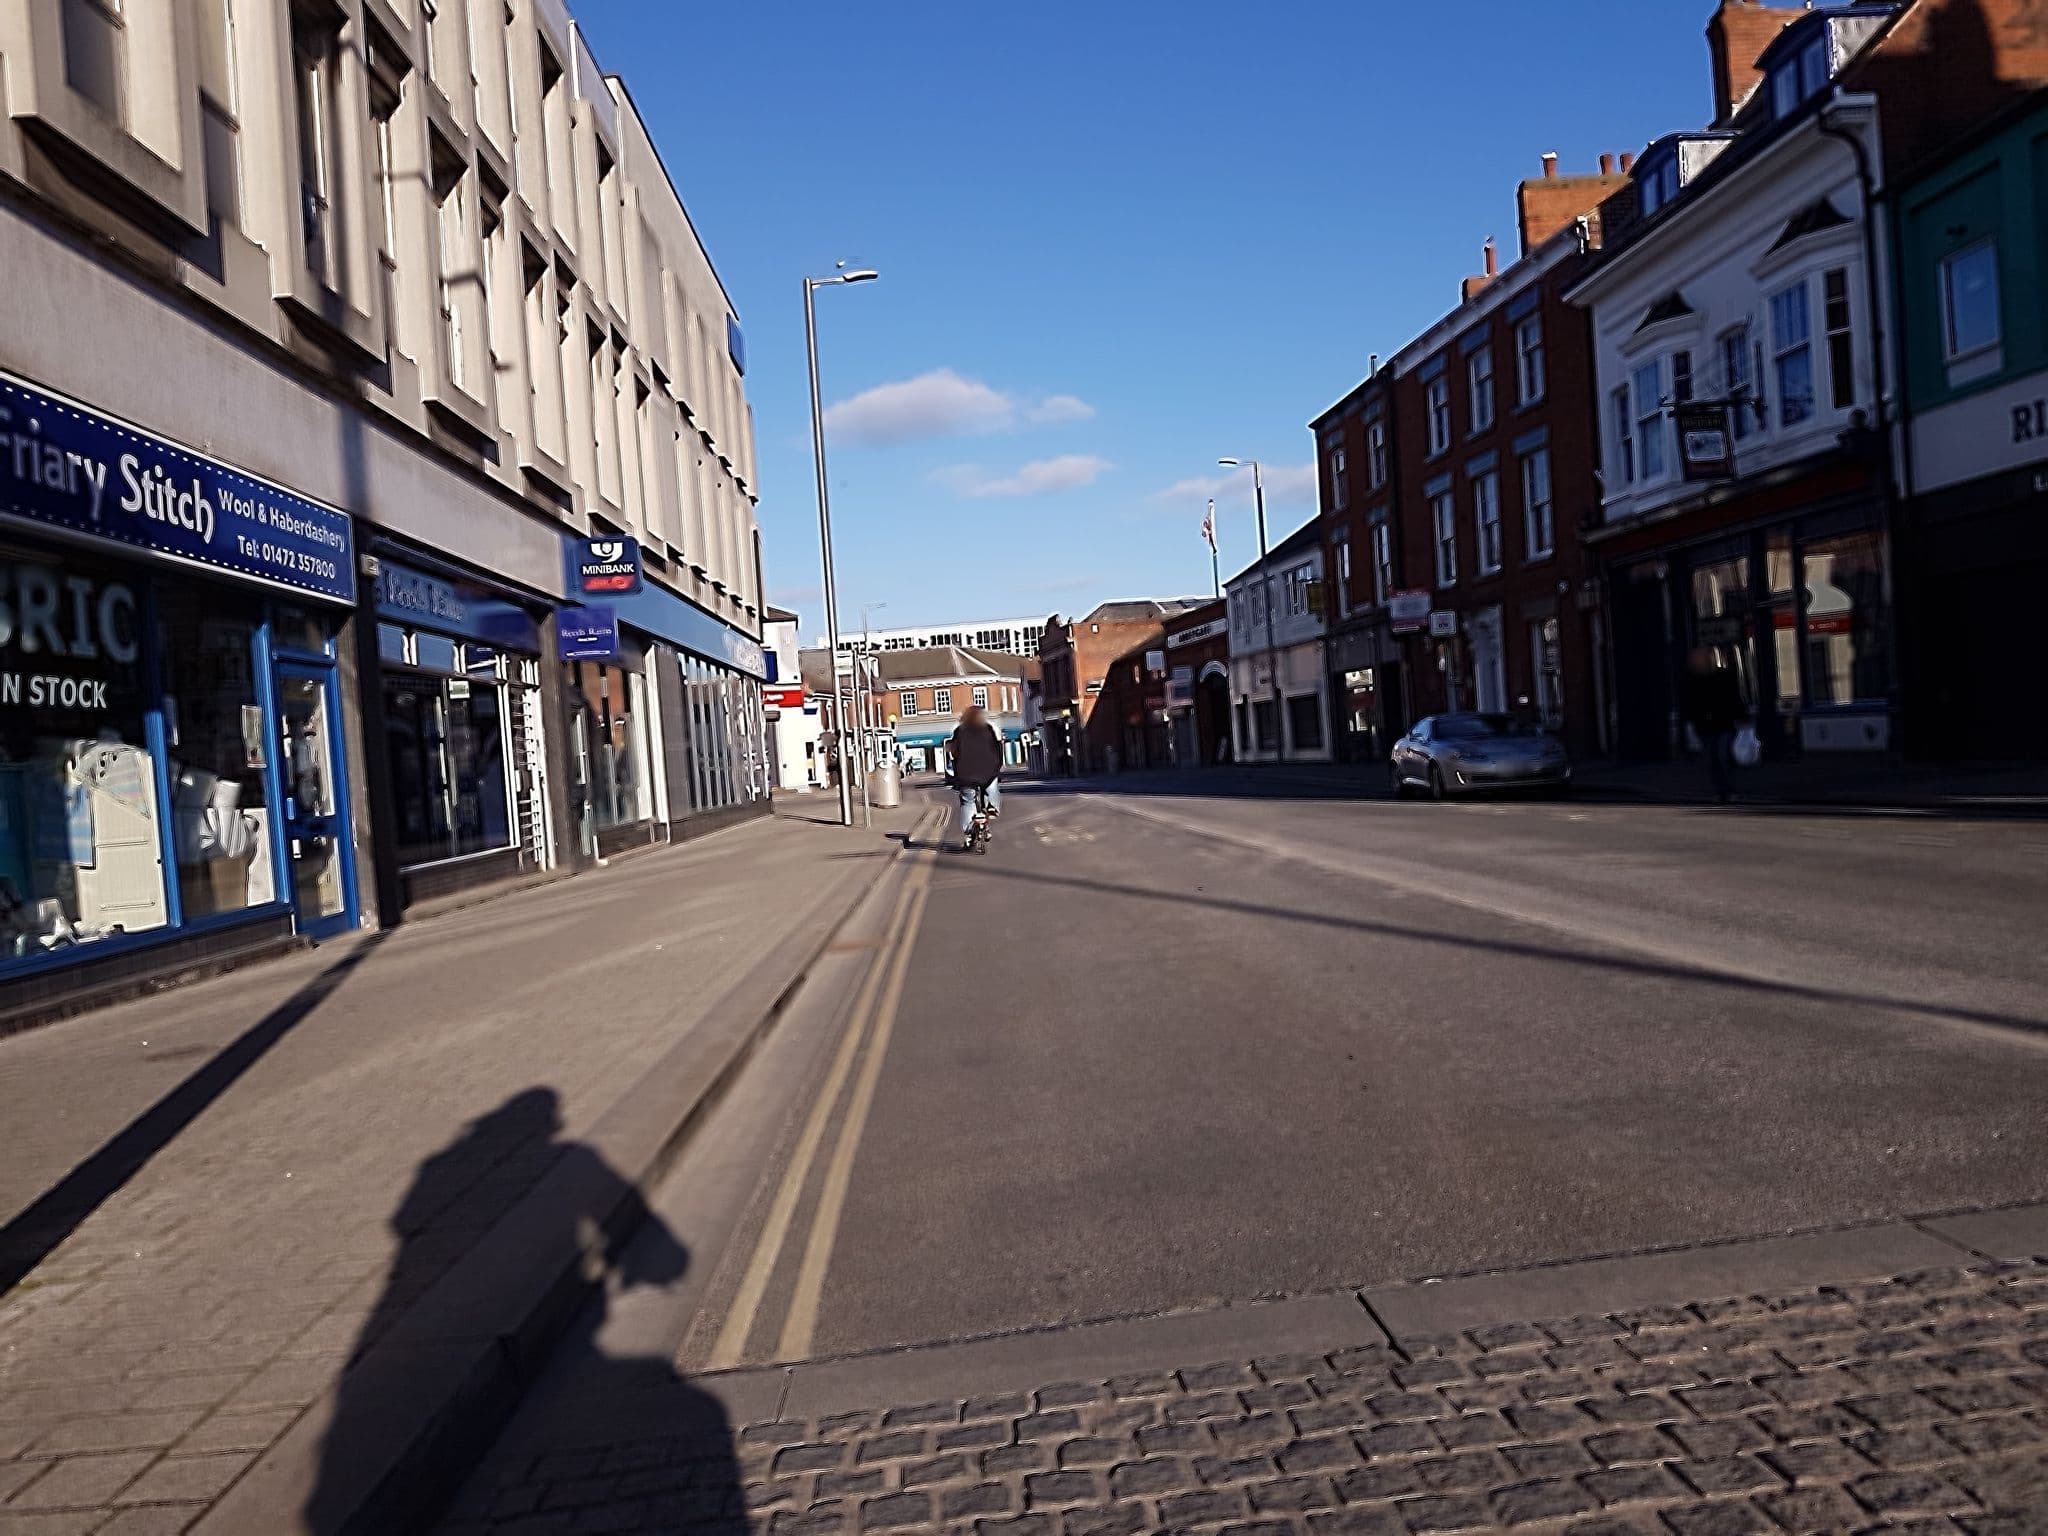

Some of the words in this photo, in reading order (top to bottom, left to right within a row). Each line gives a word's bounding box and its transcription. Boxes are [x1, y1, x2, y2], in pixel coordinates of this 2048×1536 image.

[120, 453, 214, 544] Stitch
[217, 487, 255, 520] Wool
[258, 502, 268, 524] &
[269, 506, 345, 553] Haberdashery
[237, 534, 260, 559] Tel:
[262, 543, 296, 569] 01472
[298, 553, 336, 579] 357800
[582, 563, 635, 576] MINIBANK
[29, 675, 108, 709] STOCK
